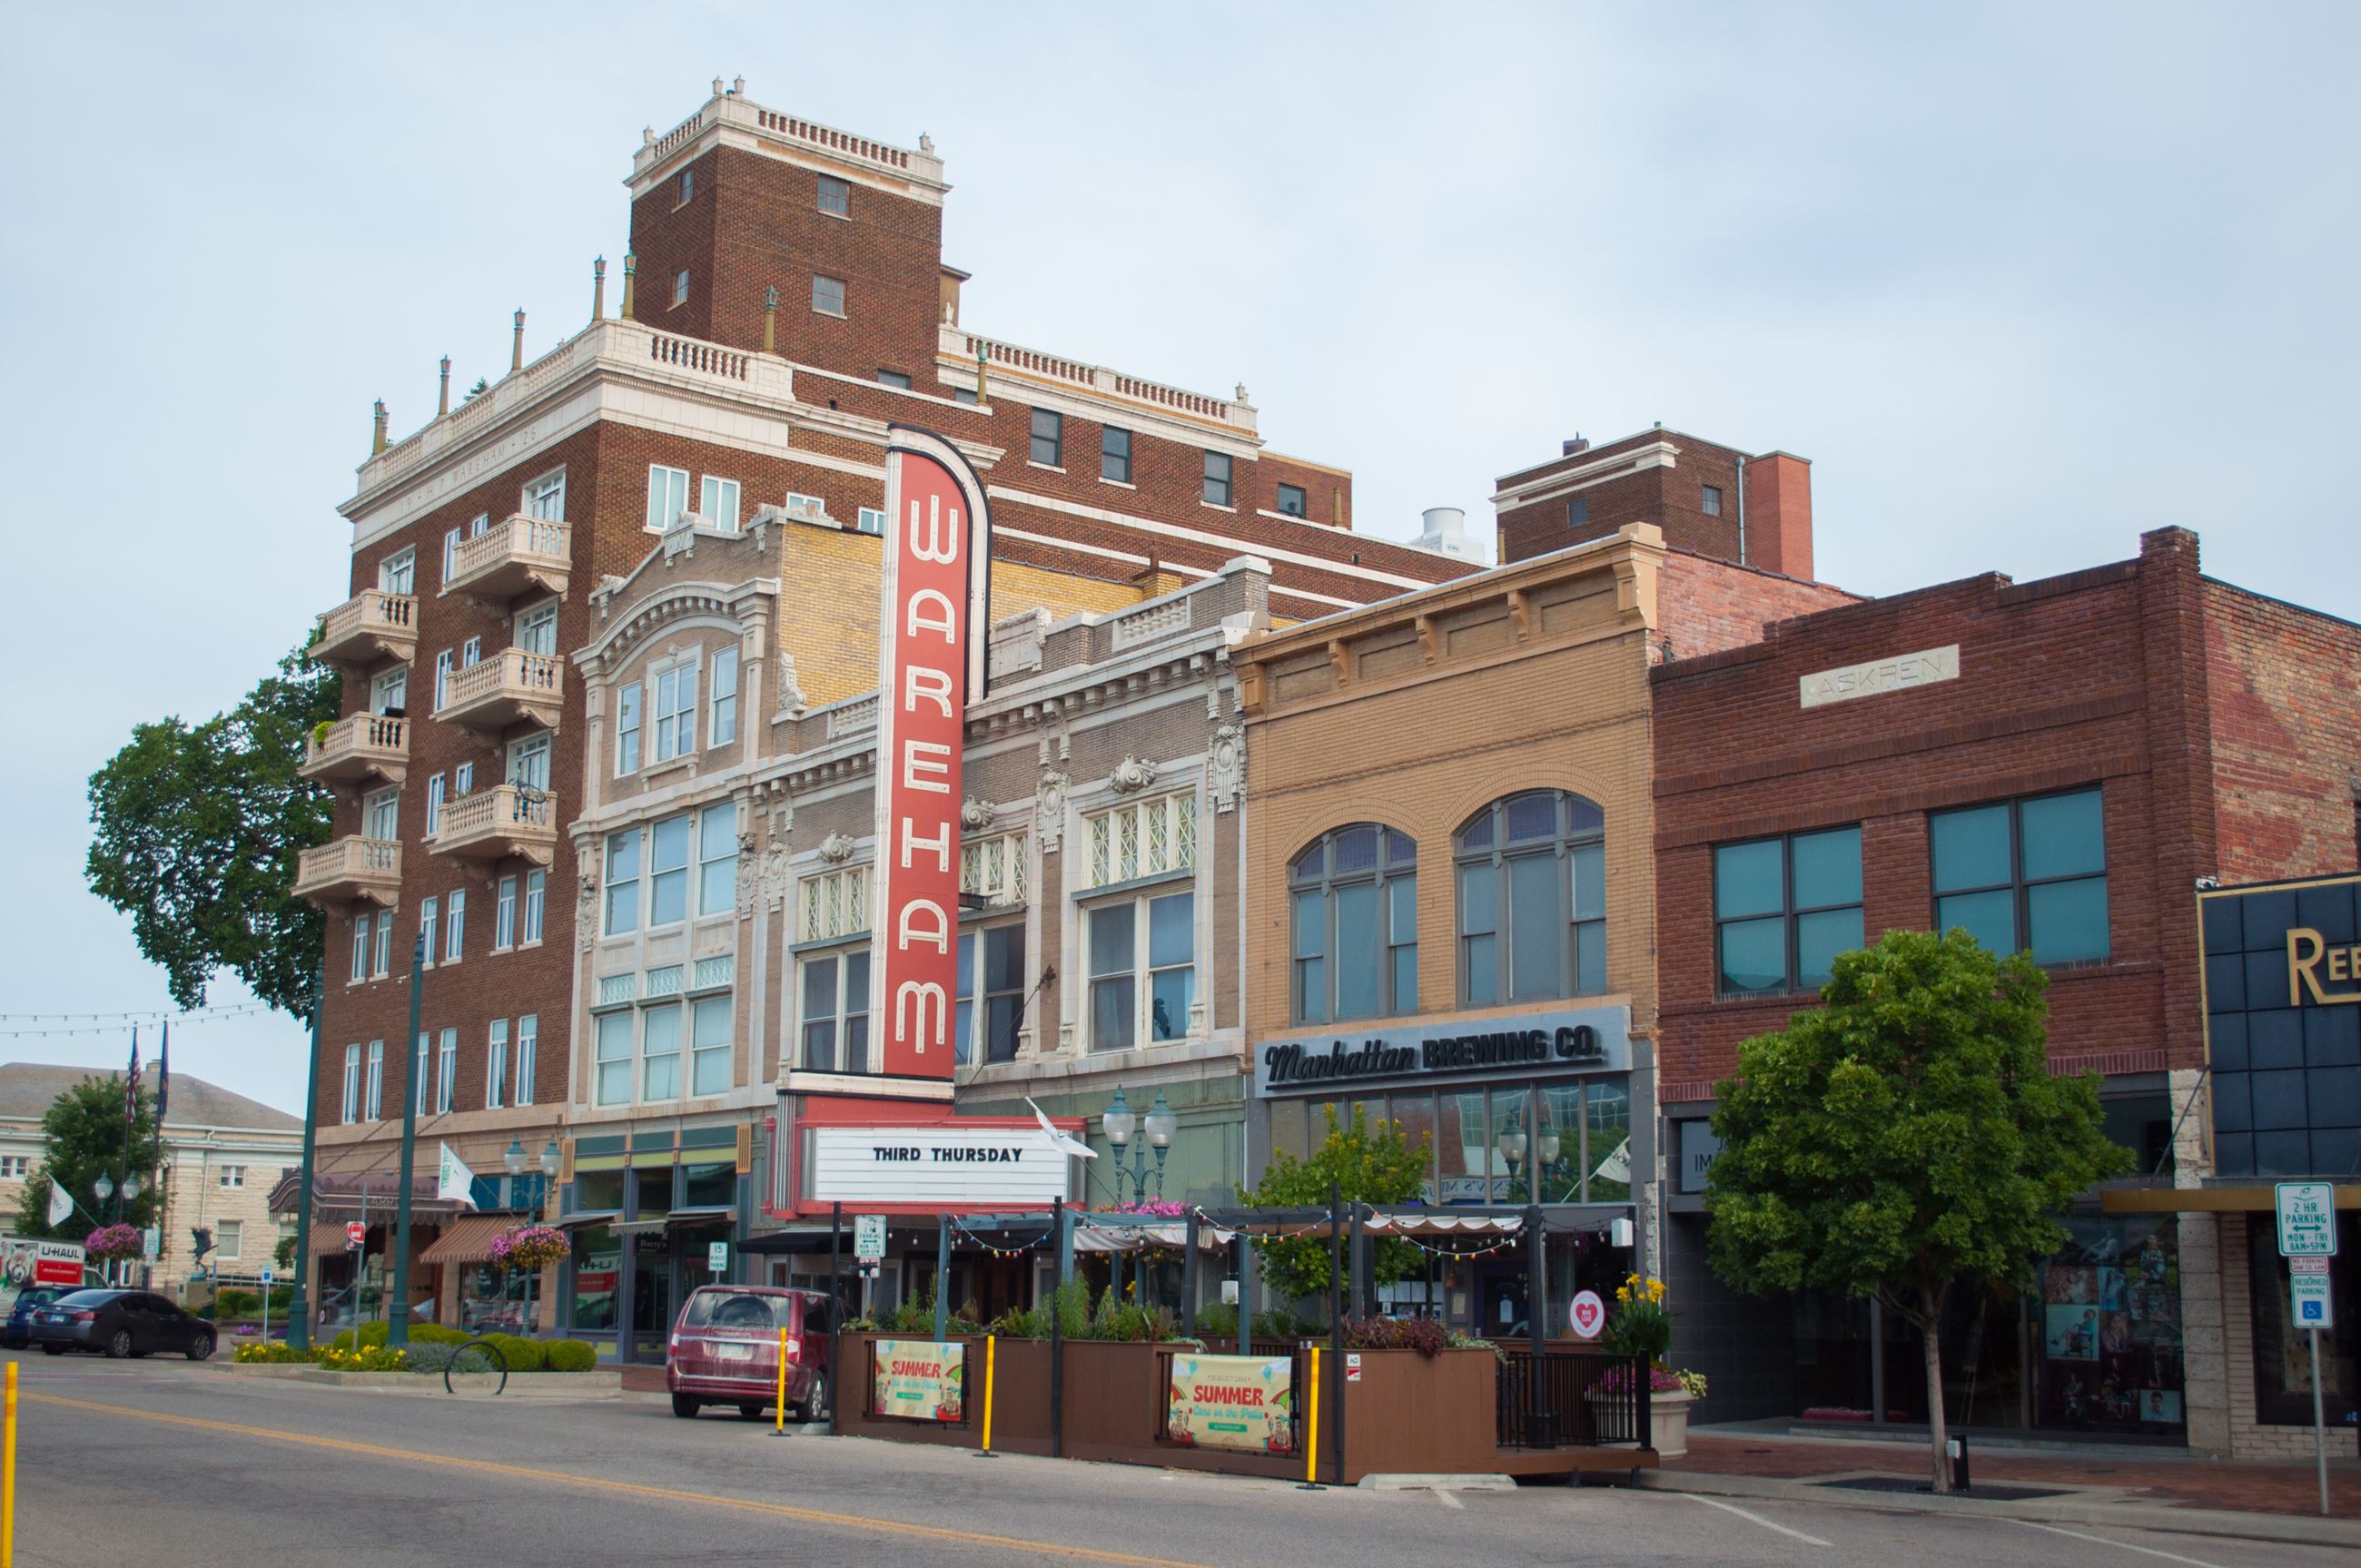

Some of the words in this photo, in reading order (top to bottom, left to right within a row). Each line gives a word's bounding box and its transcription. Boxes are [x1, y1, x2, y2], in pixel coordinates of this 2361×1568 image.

[1819, 654, 1941, 695] ASKREN
[895, 495, 958, 1054] WAREHAM
[1264, 1039, 1415, 1081] Manhattan
[1422, 1029, 1546, 1069] BREWING
[1555, 1024, 1602, 1058] CO.
[873, 1147, 921, 1161] THIRD
[932, 1147, 1022, 1162] THURSDAY
[2294, 1202, 2299, 1213] 2
[2303, 1202, 2317, 1213] HR
[2285, 1213, 2327, 1224] PARKING
[2287, 1233, 2306, 1242] MON
[2315, 1233, 2328, 1242] FRI
[42, 1246, 80, 1258] U-HAUL
[714, 1244, 724, 1254] 15
[2295, 1277, 2327, 1286] RESERVED
[2296, 1287, 2326, 1296] PARKING
[891, 1360, 942, 1378] SUMMER
[1193, 1385, 1264, 1405] SUMMER
